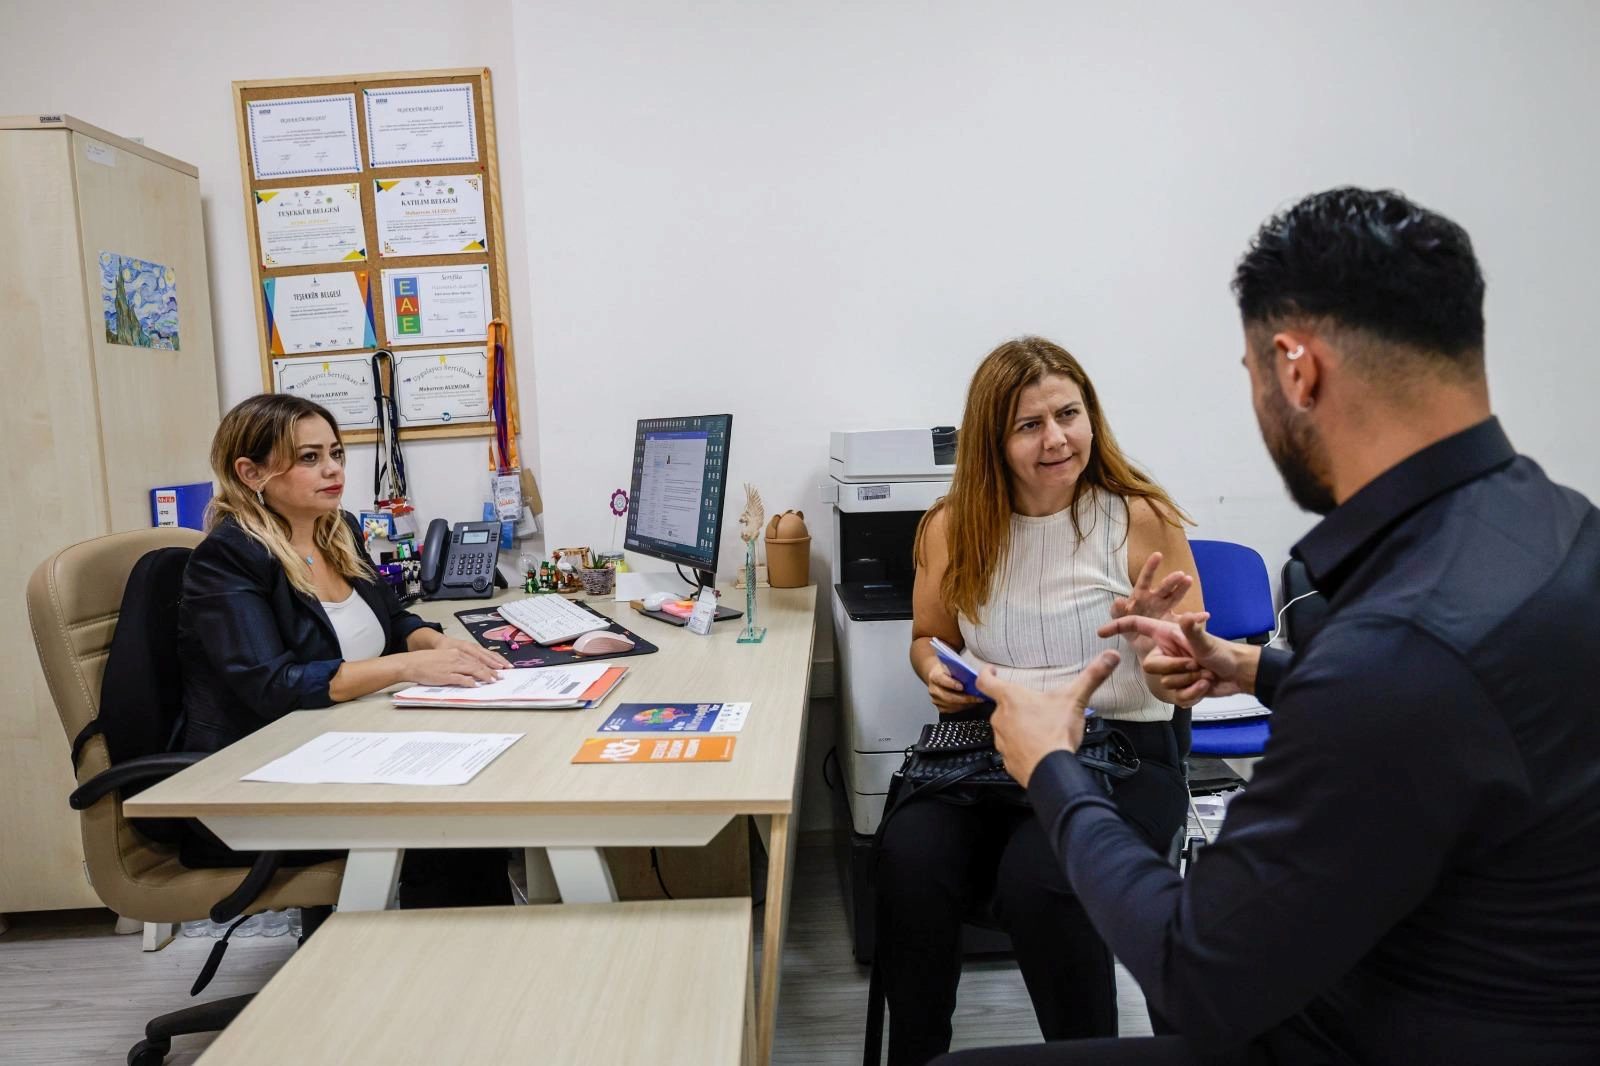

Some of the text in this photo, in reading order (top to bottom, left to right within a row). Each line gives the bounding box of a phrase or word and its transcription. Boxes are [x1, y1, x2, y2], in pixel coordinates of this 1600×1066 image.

[401, 196, 458, 206] KATILIM BELGESİ
[278, 205, 340, 217] TEŞEKKÜR BELGESİ
[399, 280, 415, 295] E
[293, 289, 341, 301] TEŞEKKÜR BELGESİ
[402, 317, 418, 332] E
[444, 383, 470, 391] ALEMDAR
